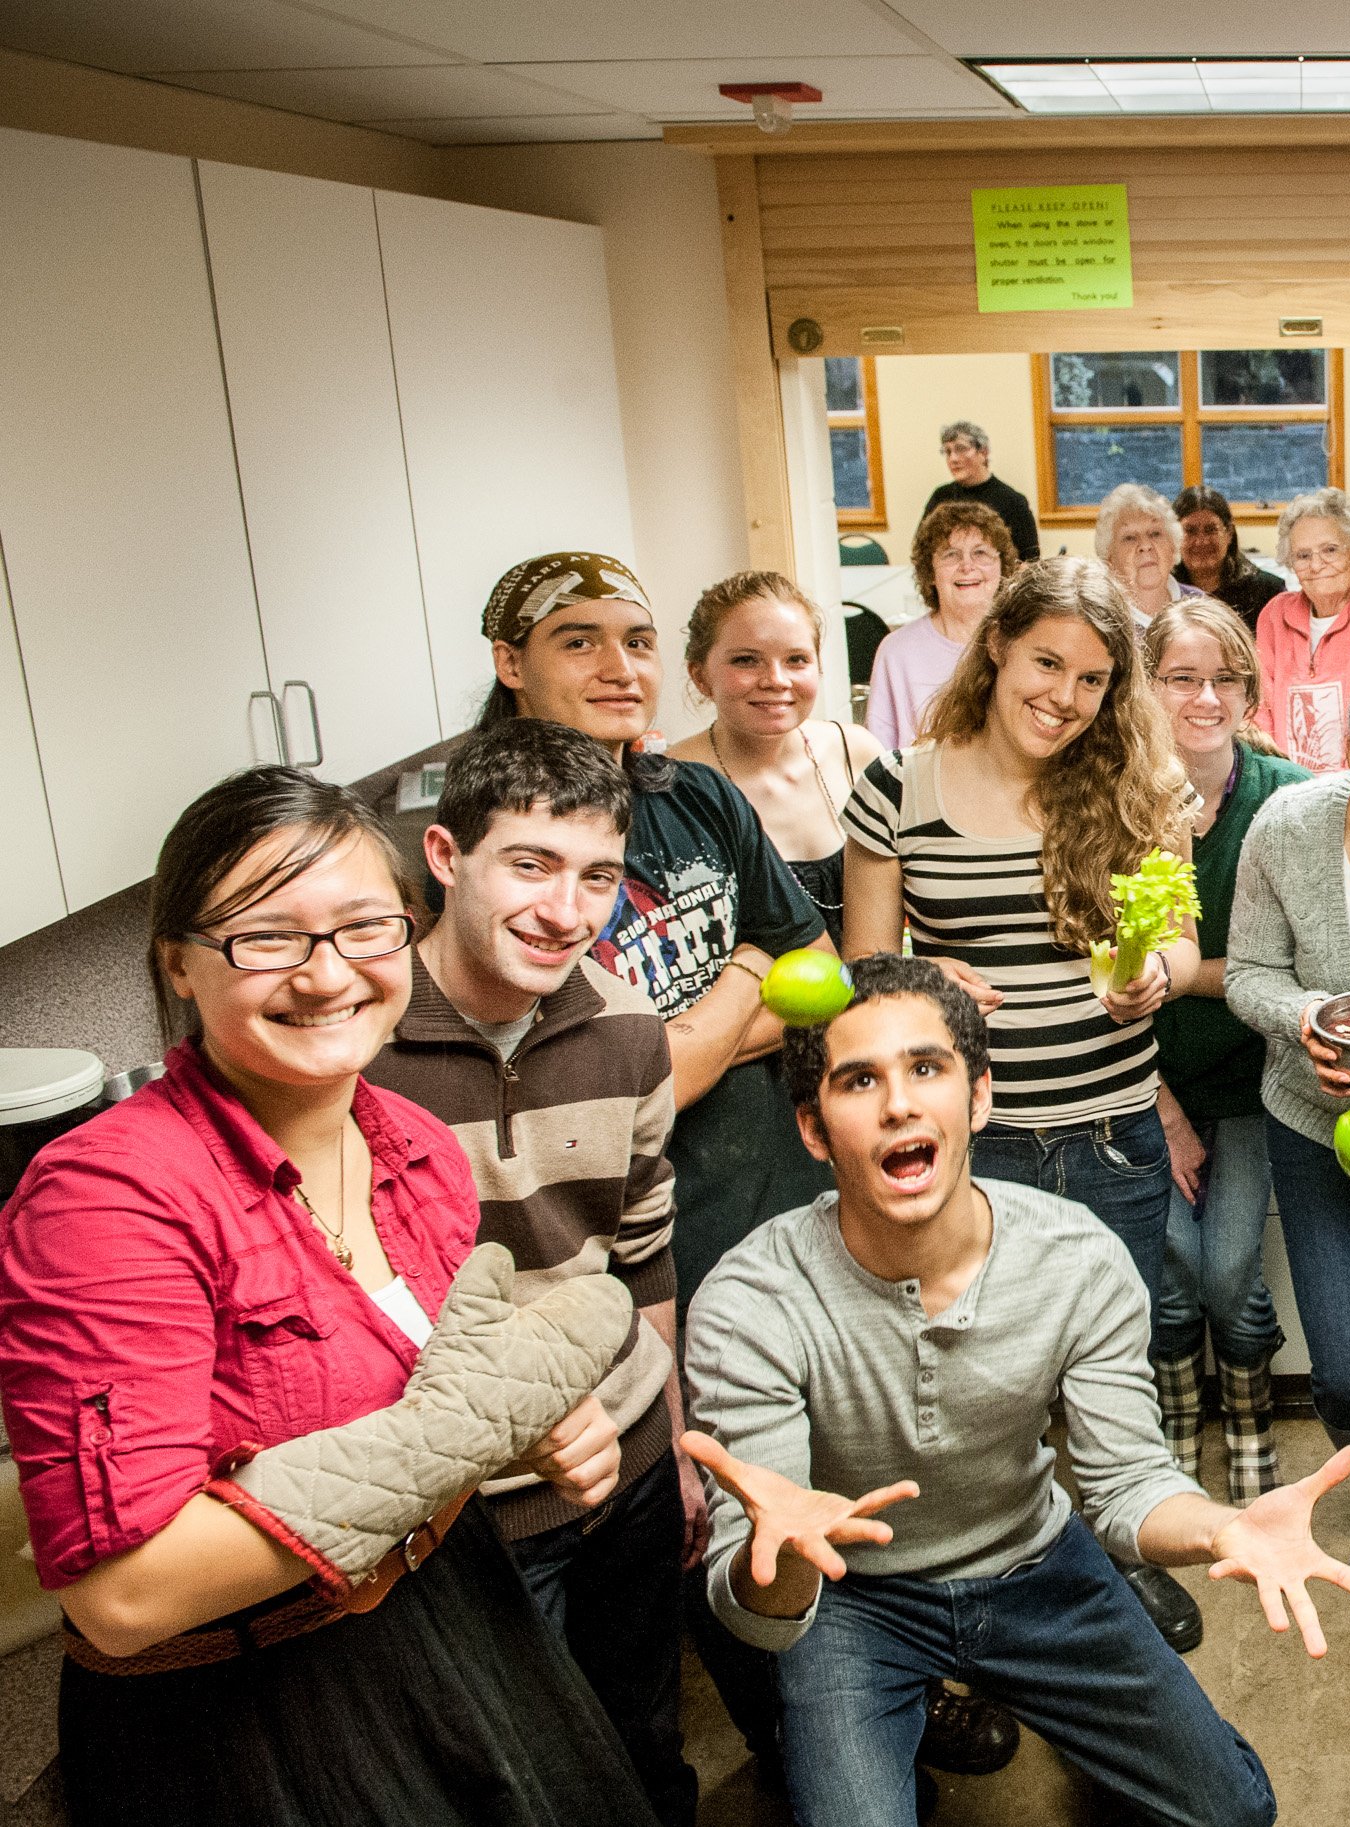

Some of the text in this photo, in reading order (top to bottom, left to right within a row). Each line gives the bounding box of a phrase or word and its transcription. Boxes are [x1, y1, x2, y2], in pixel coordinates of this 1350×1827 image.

[991, 200, 1109, 213] PLEASE KEEP OPEN!
[1056, 219, 1070, 228] the
[1076, 219, 1098, 227] stove
[1104, 218, 1114, 227] or
[1015, 239, 1029, 248] the
[1033, 238, 1058, 247] doors
[1061, 238, 1078, 247] and
[1082, 238, 1114, 246] window
[1027, 258, 1048, 267] must
[1055, 256, 1066, 266] be
[1074, 257, 1096, 267] open
[1102, 254, 1117, 264] for
[991, 278, 1019, 287] proper
[1072, 291, 1118, 303] Thank you!
